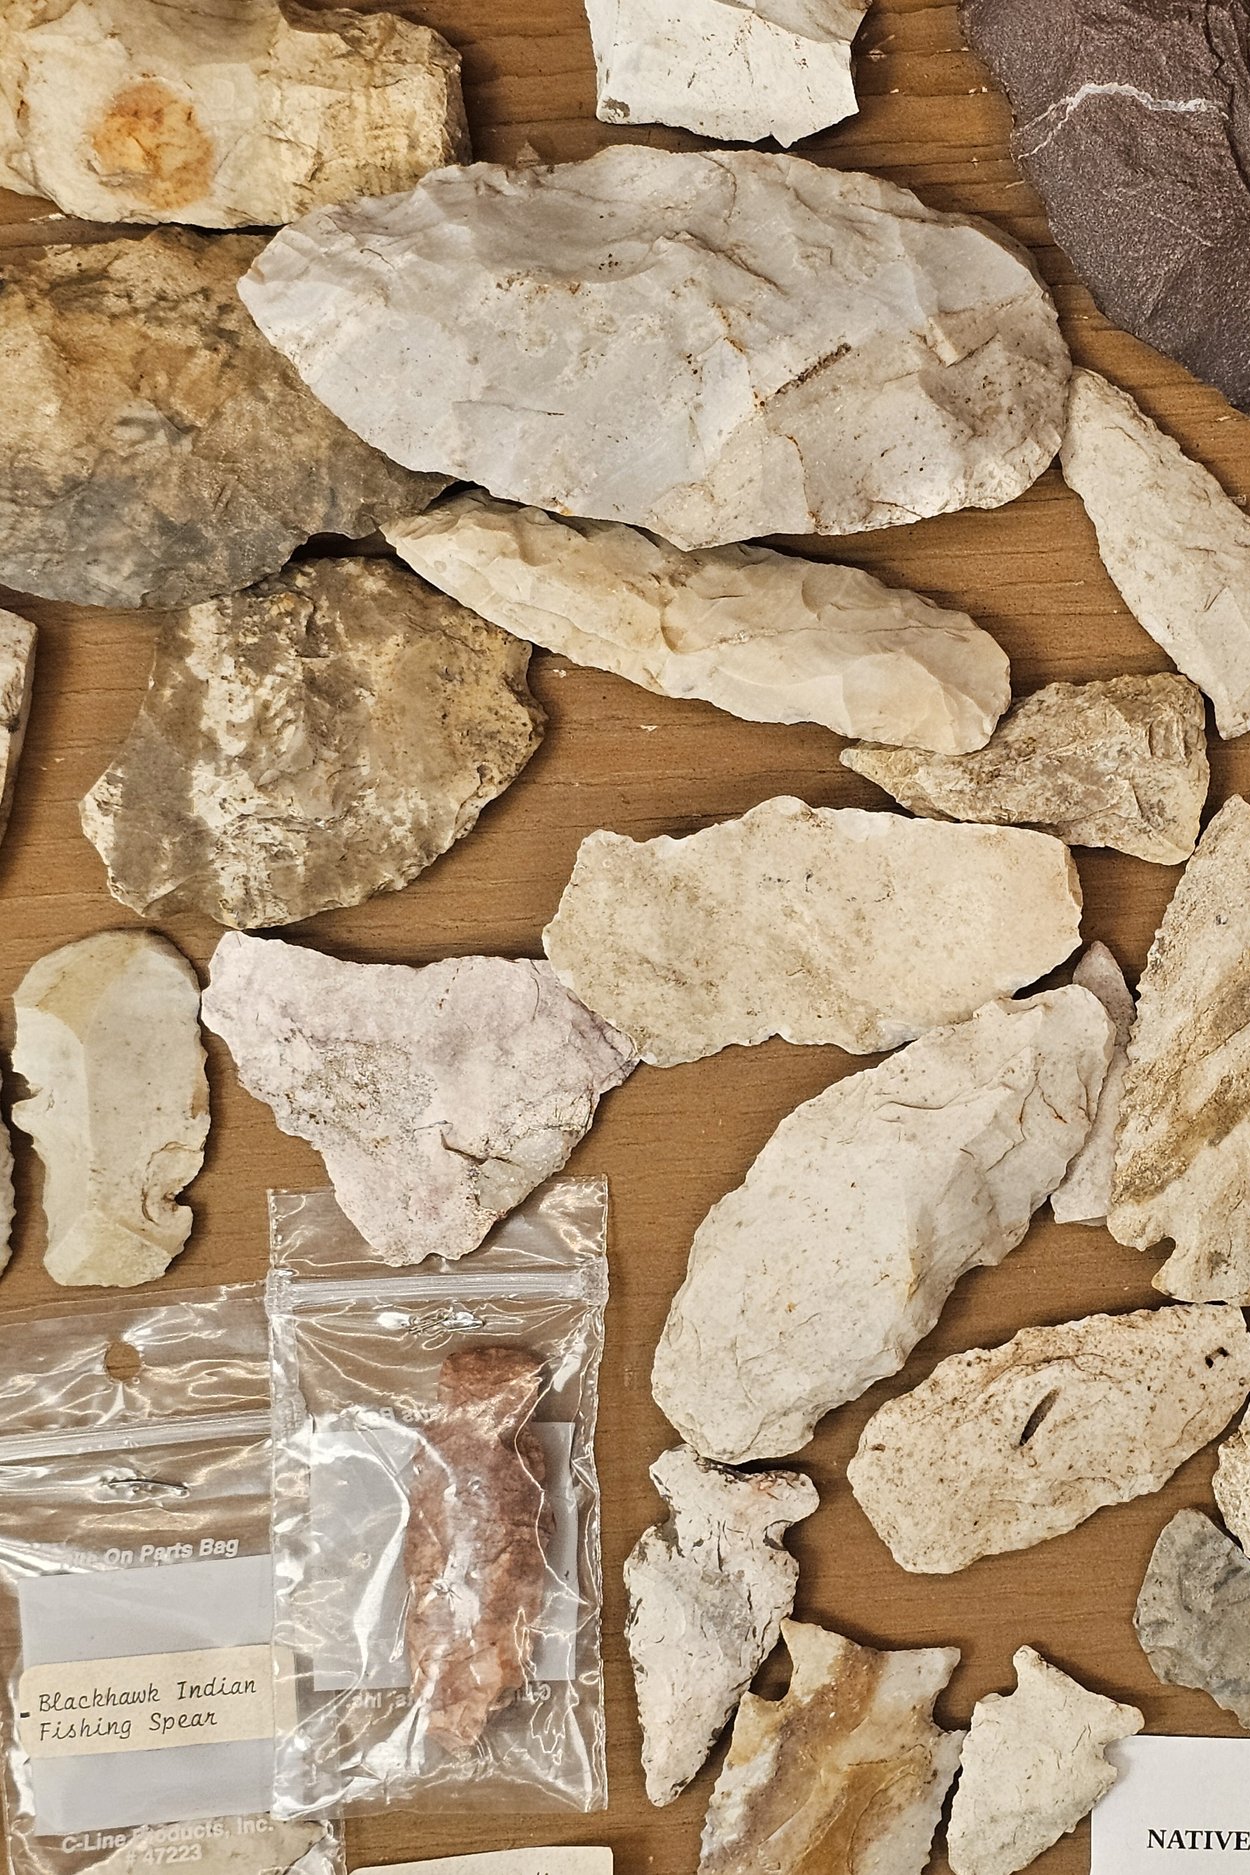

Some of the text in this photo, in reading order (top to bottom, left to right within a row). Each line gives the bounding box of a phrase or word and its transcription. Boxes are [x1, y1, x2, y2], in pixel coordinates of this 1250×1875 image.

[104, 1547, 134, 1566] On
[139, 1542, 193, 1563] Parts
[199, 1538, 240, 1557] Bag
[38, 1677, 257, 1712] Blackhawk Indian
[39, 1710, 218, 1741] Fishing Spear
[61, 1833, 128, 1854] C-Line
[237, 1818, 274, 1835] Inc.
[1146, 1828, 1250, 1851] NATIVE
[126, 1844, 203, 1865] # 47223
